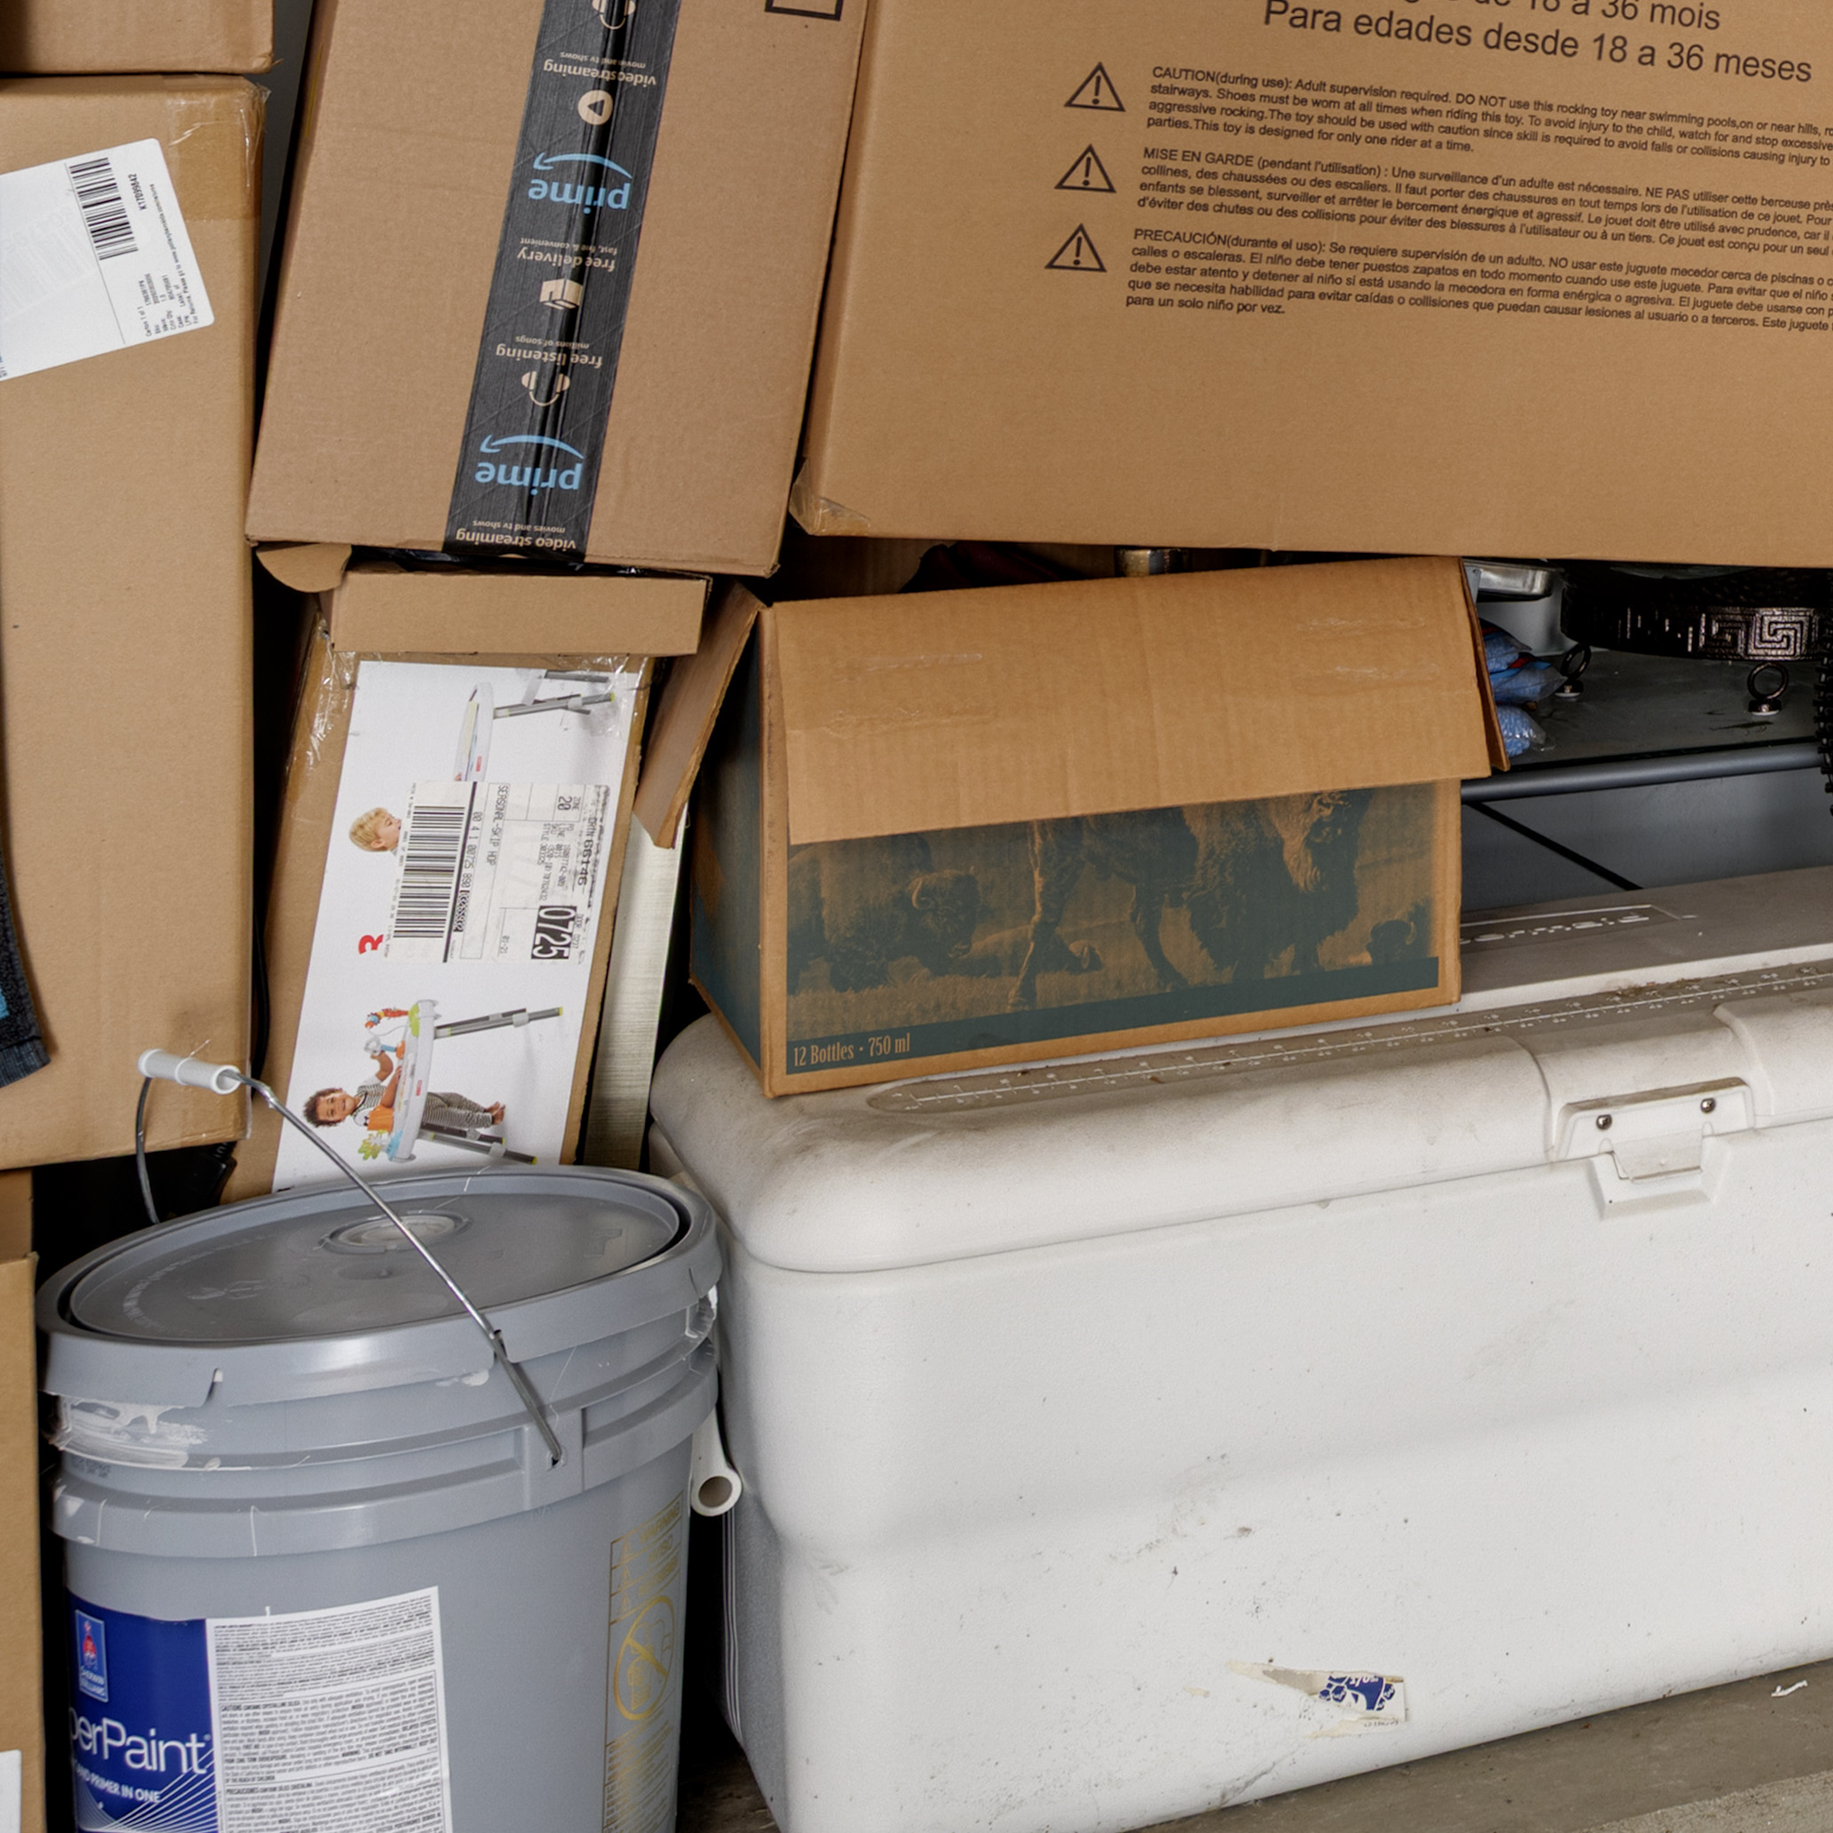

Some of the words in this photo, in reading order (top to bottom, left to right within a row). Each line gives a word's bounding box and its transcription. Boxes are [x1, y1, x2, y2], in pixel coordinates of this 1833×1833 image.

[1649, 1, 1719, 30] mois
[1353, 9, 1471, 46] edades
[1483, 21, 1578, 57] desde
[1592, 33, 1627, 63] 18
[1637, 45, 1655, 66] a
[1666, 41, 1704, 71] 36
[1713, 52, 1811, 82] meses
[543, 59, 615, 84] streaming
[1151, 65, 1258, 89] CAUTION(during
[1261, 77, 1292, 91] use):
[1293, 78, 1327, 92] Adult
[1328, 83, 1397, 98] supervision
[1399, 89, 1451, 103] required.
[1455, 92, 1475, 105] DO
[1478, 94, 1507, 107] NOT
[1508, 99, 1530, 110] use
[1533, 99, 1553, 112] this
[1556, 103, 1597, 118] rocking
[1600, 106, 1618, 120] toy
[1620, 109, 1647, 119] near
[1648, 111, 1704, 127] swimming
[1706, 116, 1753, 129] pools,on
[1755, 121, 1768, 130] or
[1770, 122, 1795, 132] near
[1797, 122, 1821, 136] hills,
[527, 178, 631, 214] prime
[517, 247, 586, 269] delivery
[585, 256, 615, 272] free
[516, 335, 542, 344] songs
[496, 343, 575, 365] listening
[573, 353, 602, 368] free
[474, 461, 583, 495] prime
[472, 519, 500, 529] shows
[455, 527, 537, 546] streaming
[536, 534, 576, 551] video
[557, 796, 571, 810] 20
[486, 850, 497, 865] HOP
[532, 905, 576, 960] 0725
[794, 1046, 807, 1067] 12
[810, 1041, 855, 1065] Bottles
[868, 1035, 891, 1058] 750
[894, 1032, 911, 1054] ml
[69, 1706, 206, 1775] erPaint
[121, 1786, 134, 1799] IN
[135, 1789, 161, 1803] ONE
